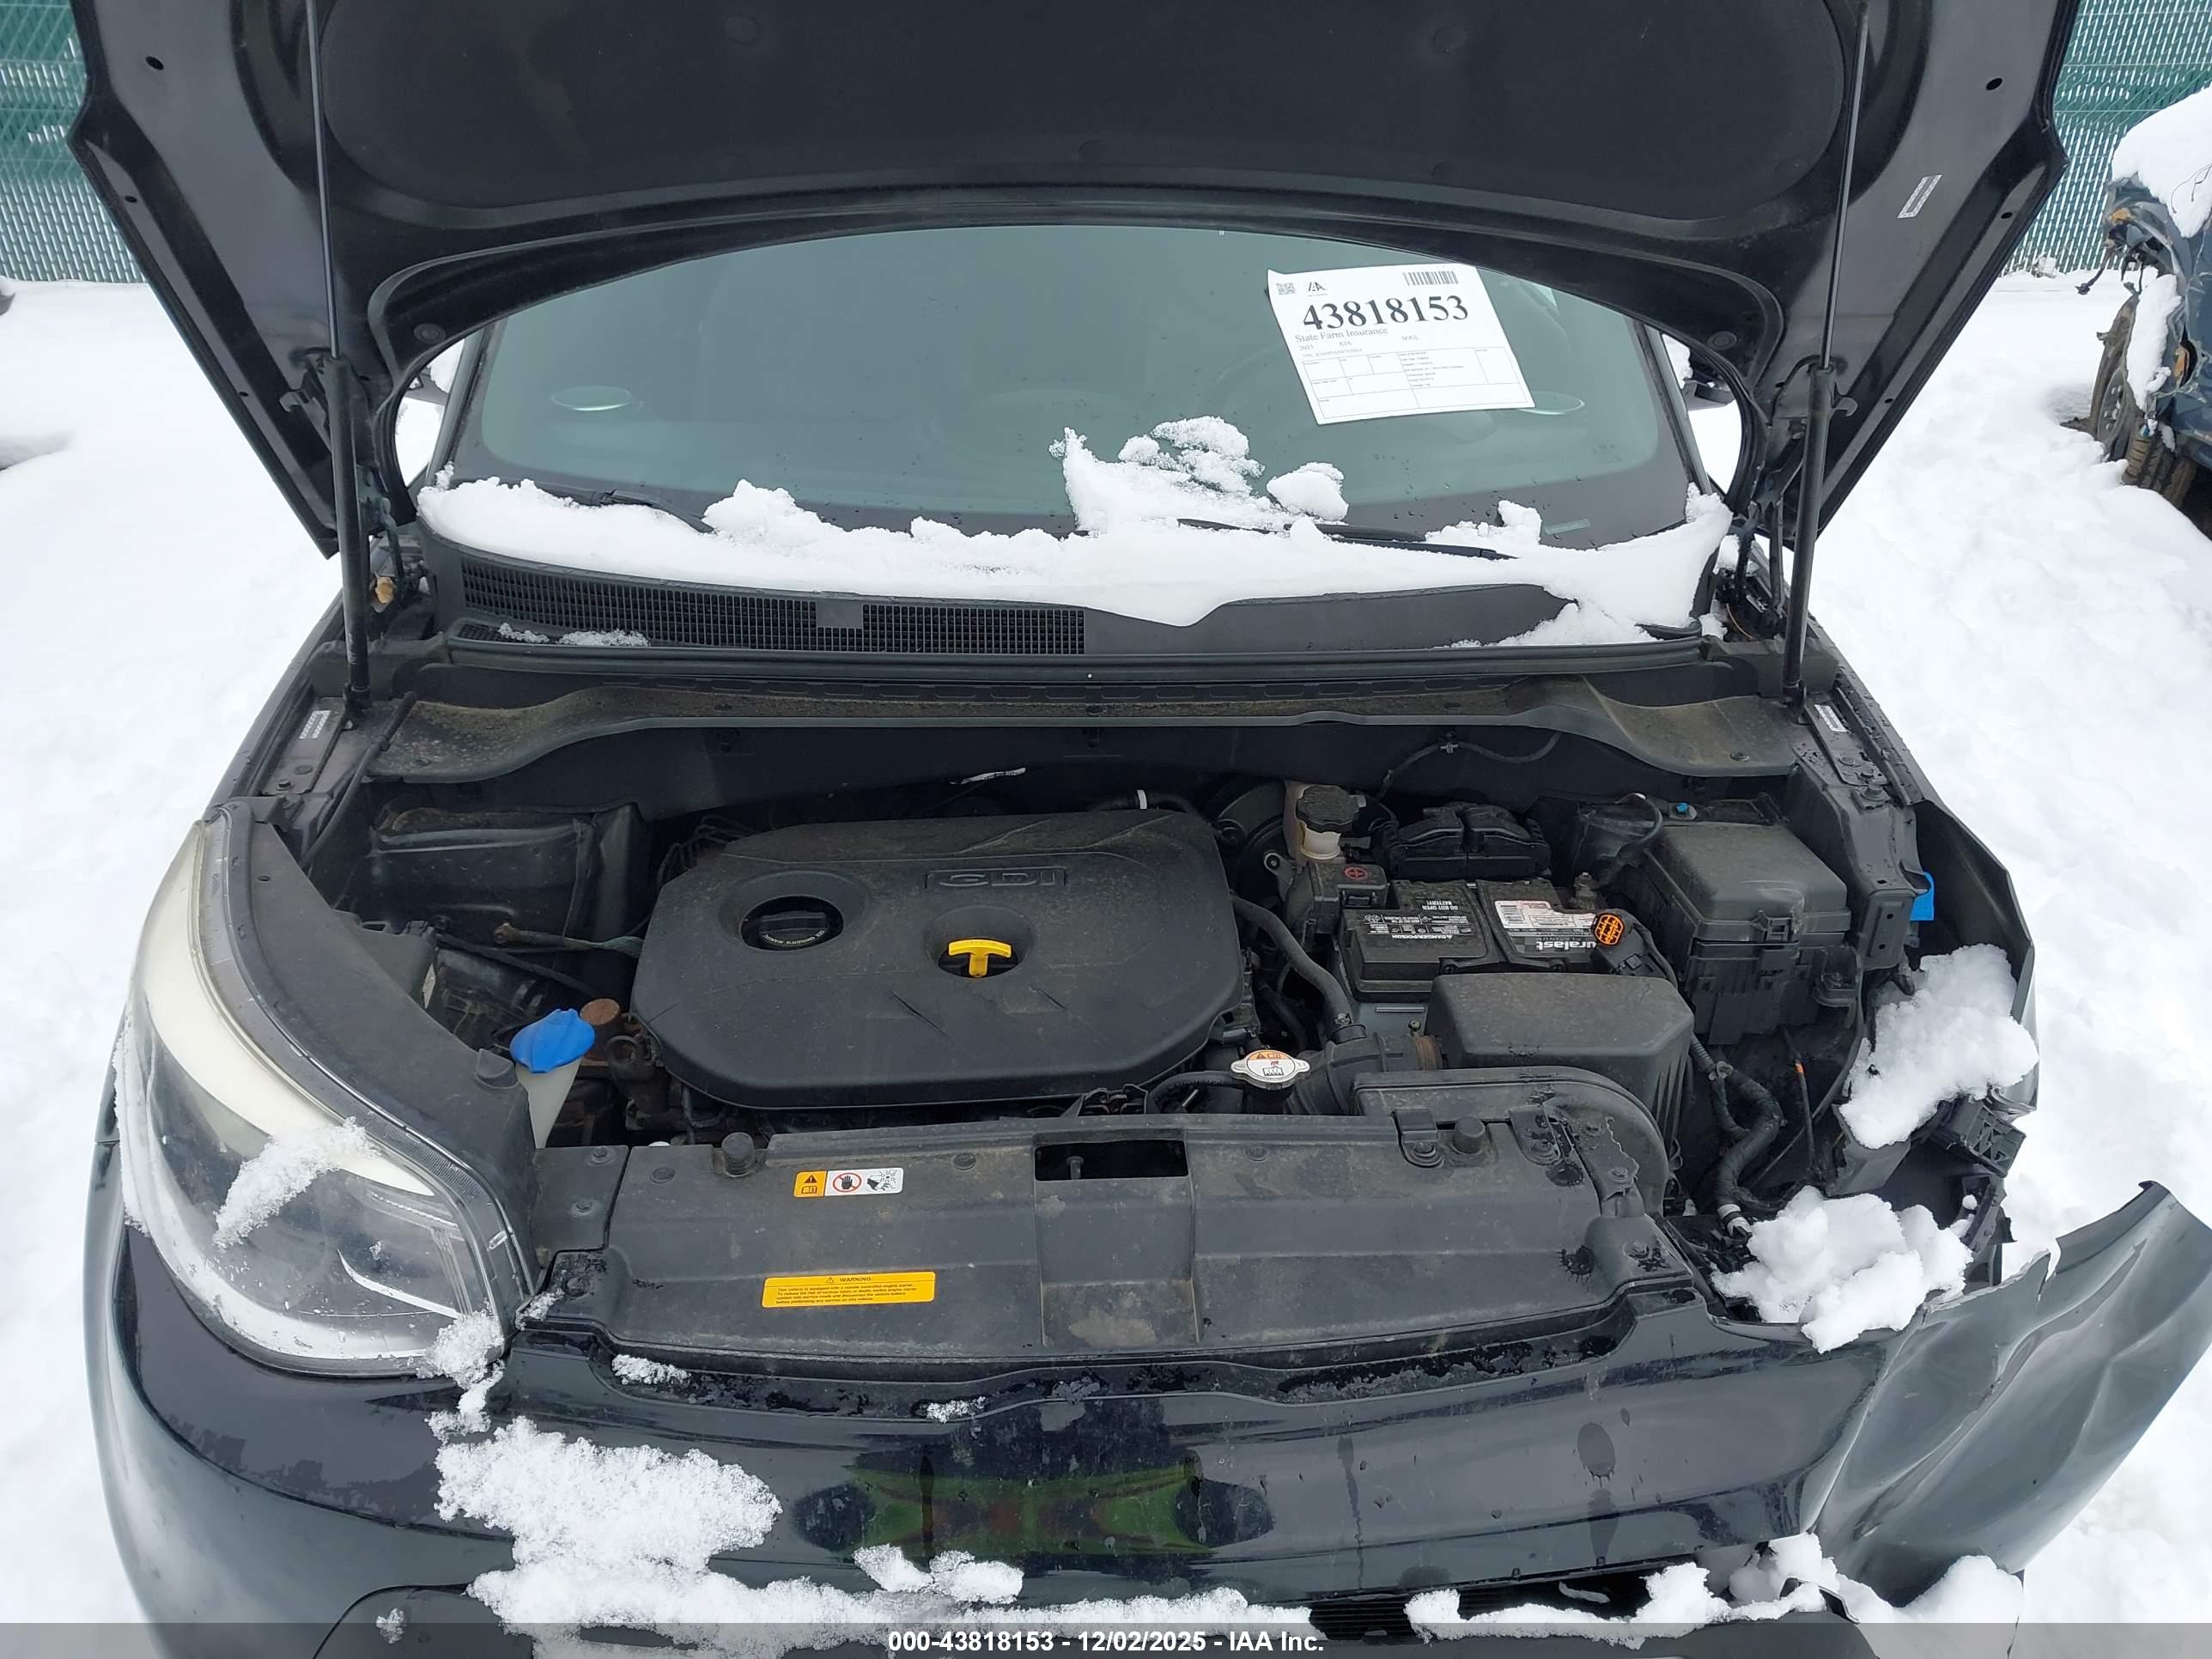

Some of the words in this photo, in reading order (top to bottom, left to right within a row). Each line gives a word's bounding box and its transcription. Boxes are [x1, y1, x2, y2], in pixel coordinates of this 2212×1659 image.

[1304, 295, 1468, 330] 43818153
[1295, 333, 1319, 343] State
[1320, 331, 1344, 340] Farm
[1346, 328, 1388, 337] Insurance
[939, 872, 1055, 886] GDI
[1535, 940, 1597, 950] uralast
